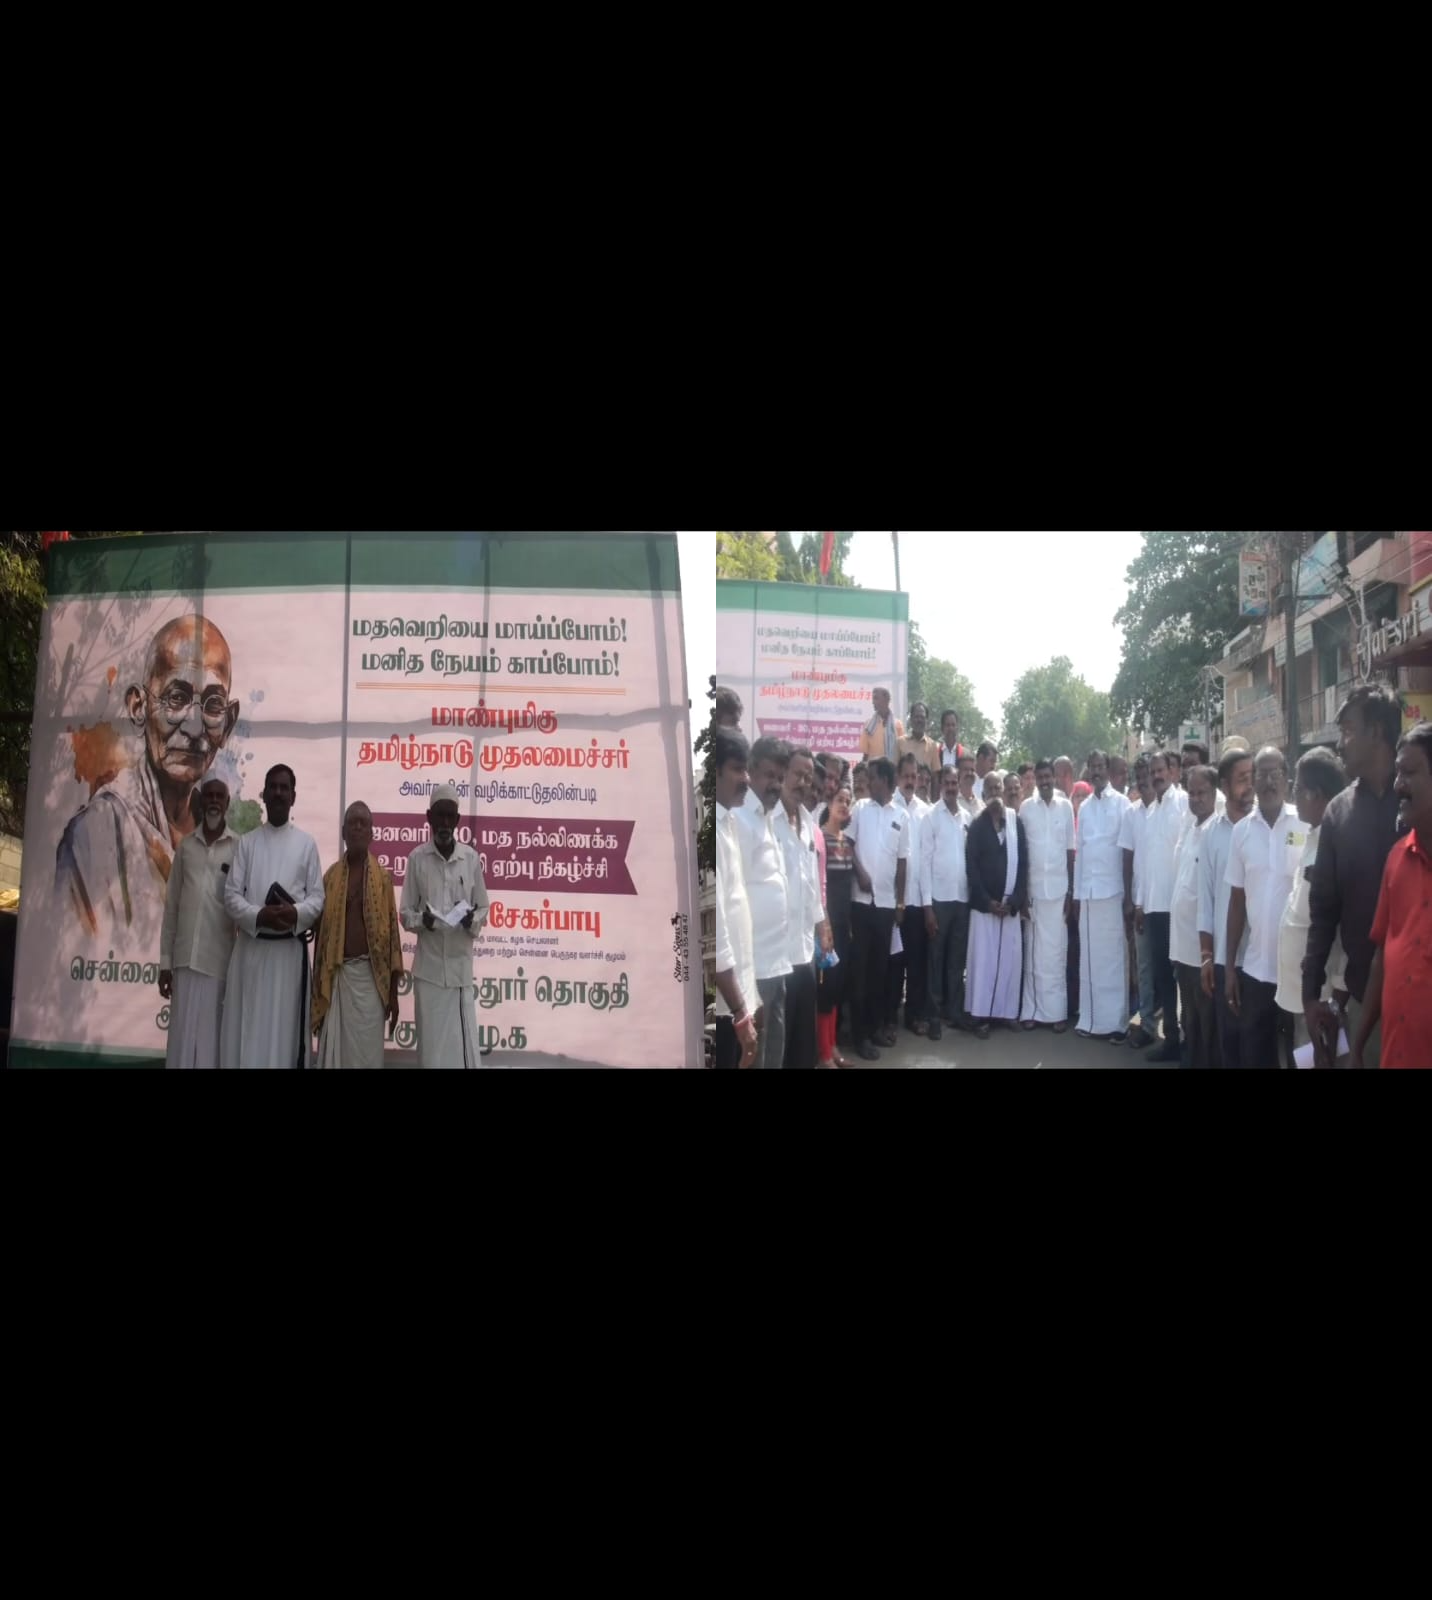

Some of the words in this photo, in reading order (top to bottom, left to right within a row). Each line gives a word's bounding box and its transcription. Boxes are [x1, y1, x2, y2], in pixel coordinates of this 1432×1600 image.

[353, 614, 488, 642] மதவெறியை
[495, 614, 627, 642] மாய்ப்போம்!
[362, 647, 424, 676] மனித
[431, 648, 501, 677] நேயம்
[507, 649, 619, 676] காப்போம்!
[431, 698, 558, 734] மாண்புமிகு
[357, 733, 474, 769] தமிழ்நாடு
[479, 738, 629, 772] முதலமைச்சர்
[482, 829, 512, 849] மத
[516, 825, 618, 850] நல்லிணக்க
[493, 853, 533, 880] ஏற்பு
[538, 856, 608, 883] நிகழ்ச்சி
[71, 950, 160, 984] சென்னை
[535, 972, 630, 1013] தொகுதி
